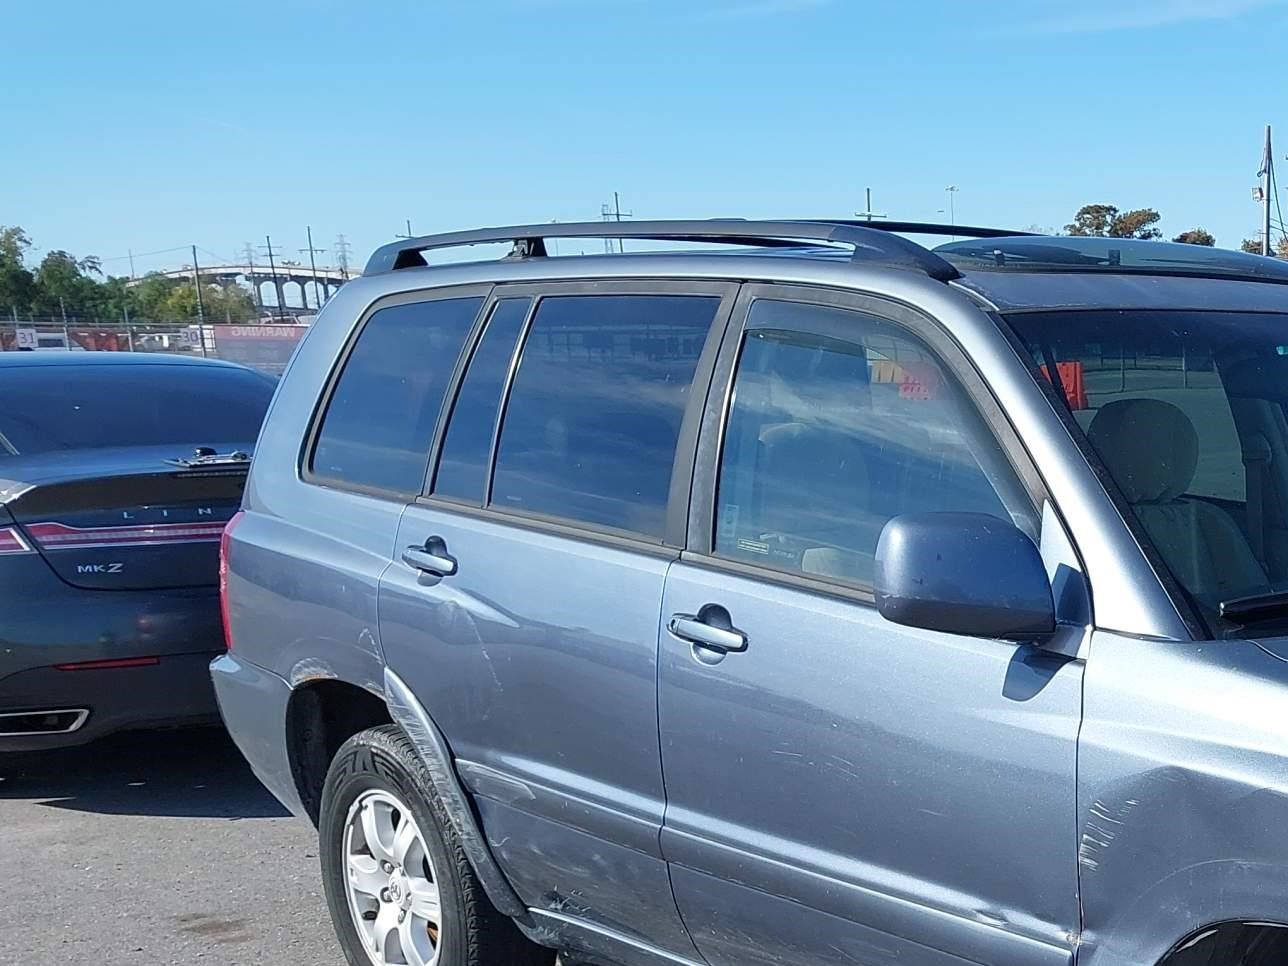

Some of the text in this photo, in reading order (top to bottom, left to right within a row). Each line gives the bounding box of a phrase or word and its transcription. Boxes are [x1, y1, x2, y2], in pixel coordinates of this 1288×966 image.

[17, 332, 35, 344] 31
[181, 331, 199, 343] 30
[76, 562, 123, 573] MKZ
